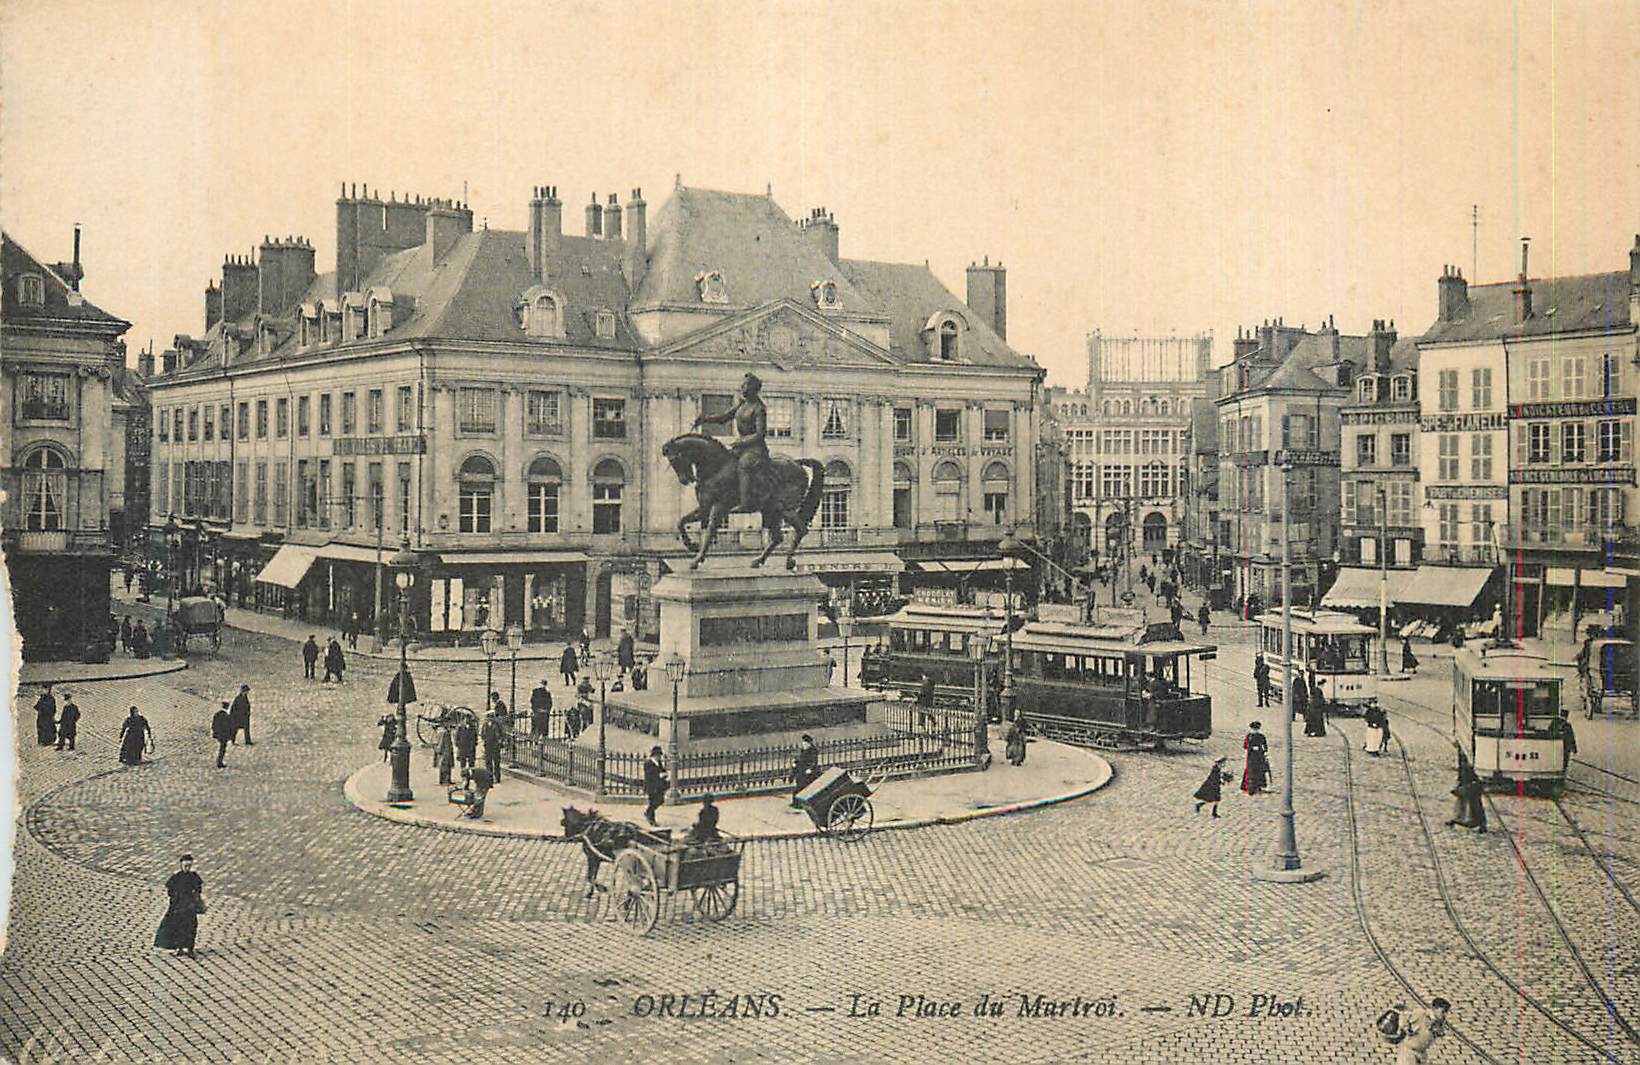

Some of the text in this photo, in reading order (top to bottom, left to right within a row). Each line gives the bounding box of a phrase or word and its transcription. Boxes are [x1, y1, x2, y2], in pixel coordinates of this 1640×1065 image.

[1455, 412, 1508, 430] FLANELLE
[932, 447, 966, 456] ARTICLES
[981, 447, 1012, 456] VOYAGE
[916, 590, 955, 598] CHOCOLAT
